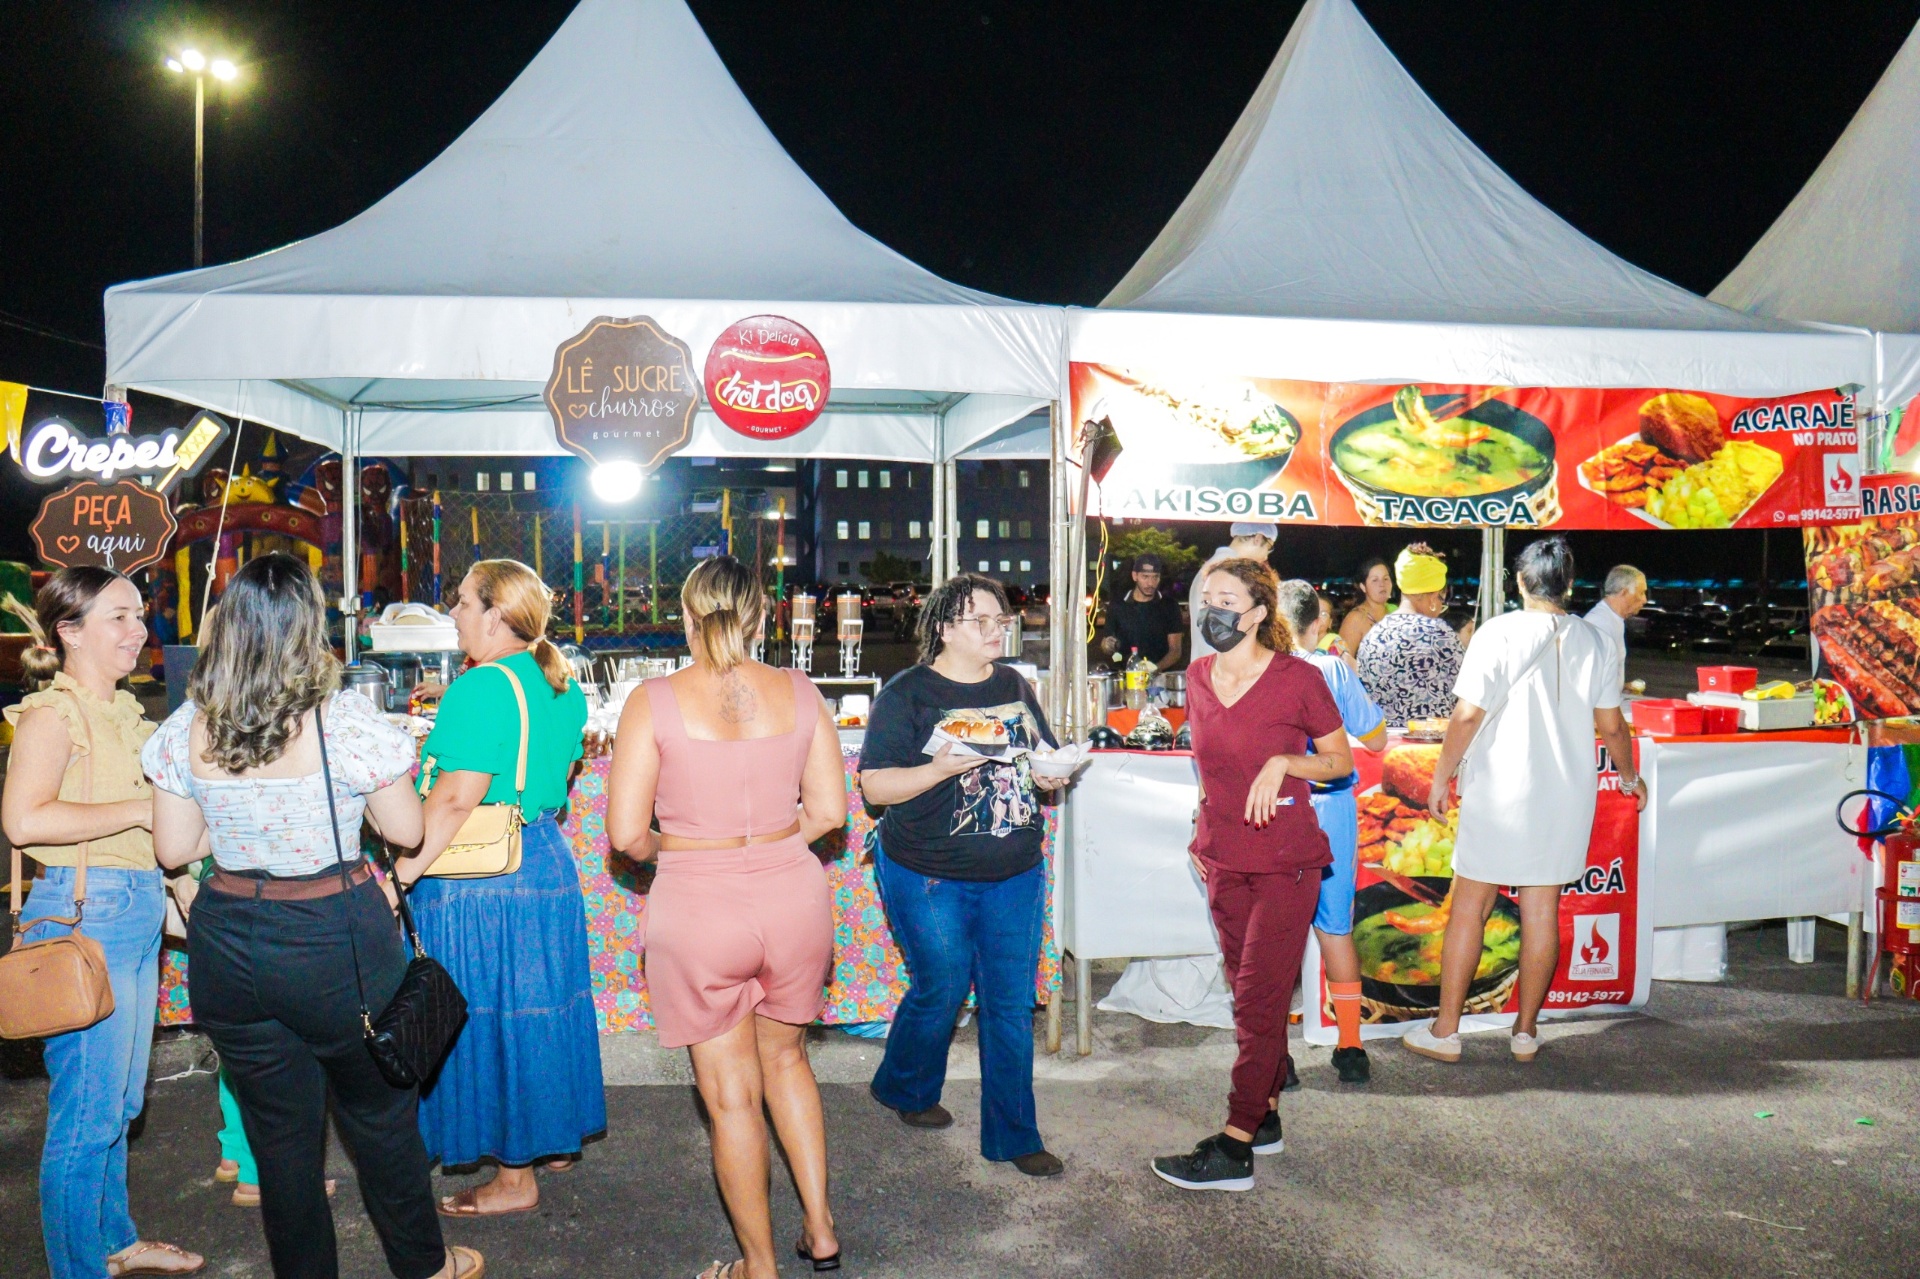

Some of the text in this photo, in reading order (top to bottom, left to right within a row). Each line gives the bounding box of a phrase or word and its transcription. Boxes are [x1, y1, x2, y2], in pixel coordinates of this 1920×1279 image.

[567, 357, 683, 394] LÊ SUCRE
[723, 370, 816, 412] hot dog
[589, 385, 680, 419] churros
[1731, 396, 1856, 434] ACARAJÉ
[25, 423, 180, 479] Crepes
[593, 429, 661, 440] gourmet
[1792, 431, 1858, 446] NO PRATO
[73, 495, 132, 533] PEÇA
[1106, 487, 1316, 518] AKISOBA
[1374, 491, 1538, 526] TACACÁ
[1800, 508, 1861, 520] 99142-5977
[87, 532, 146, 568] aqui
[1548, 990, 1625, 1003] 99142-5977
